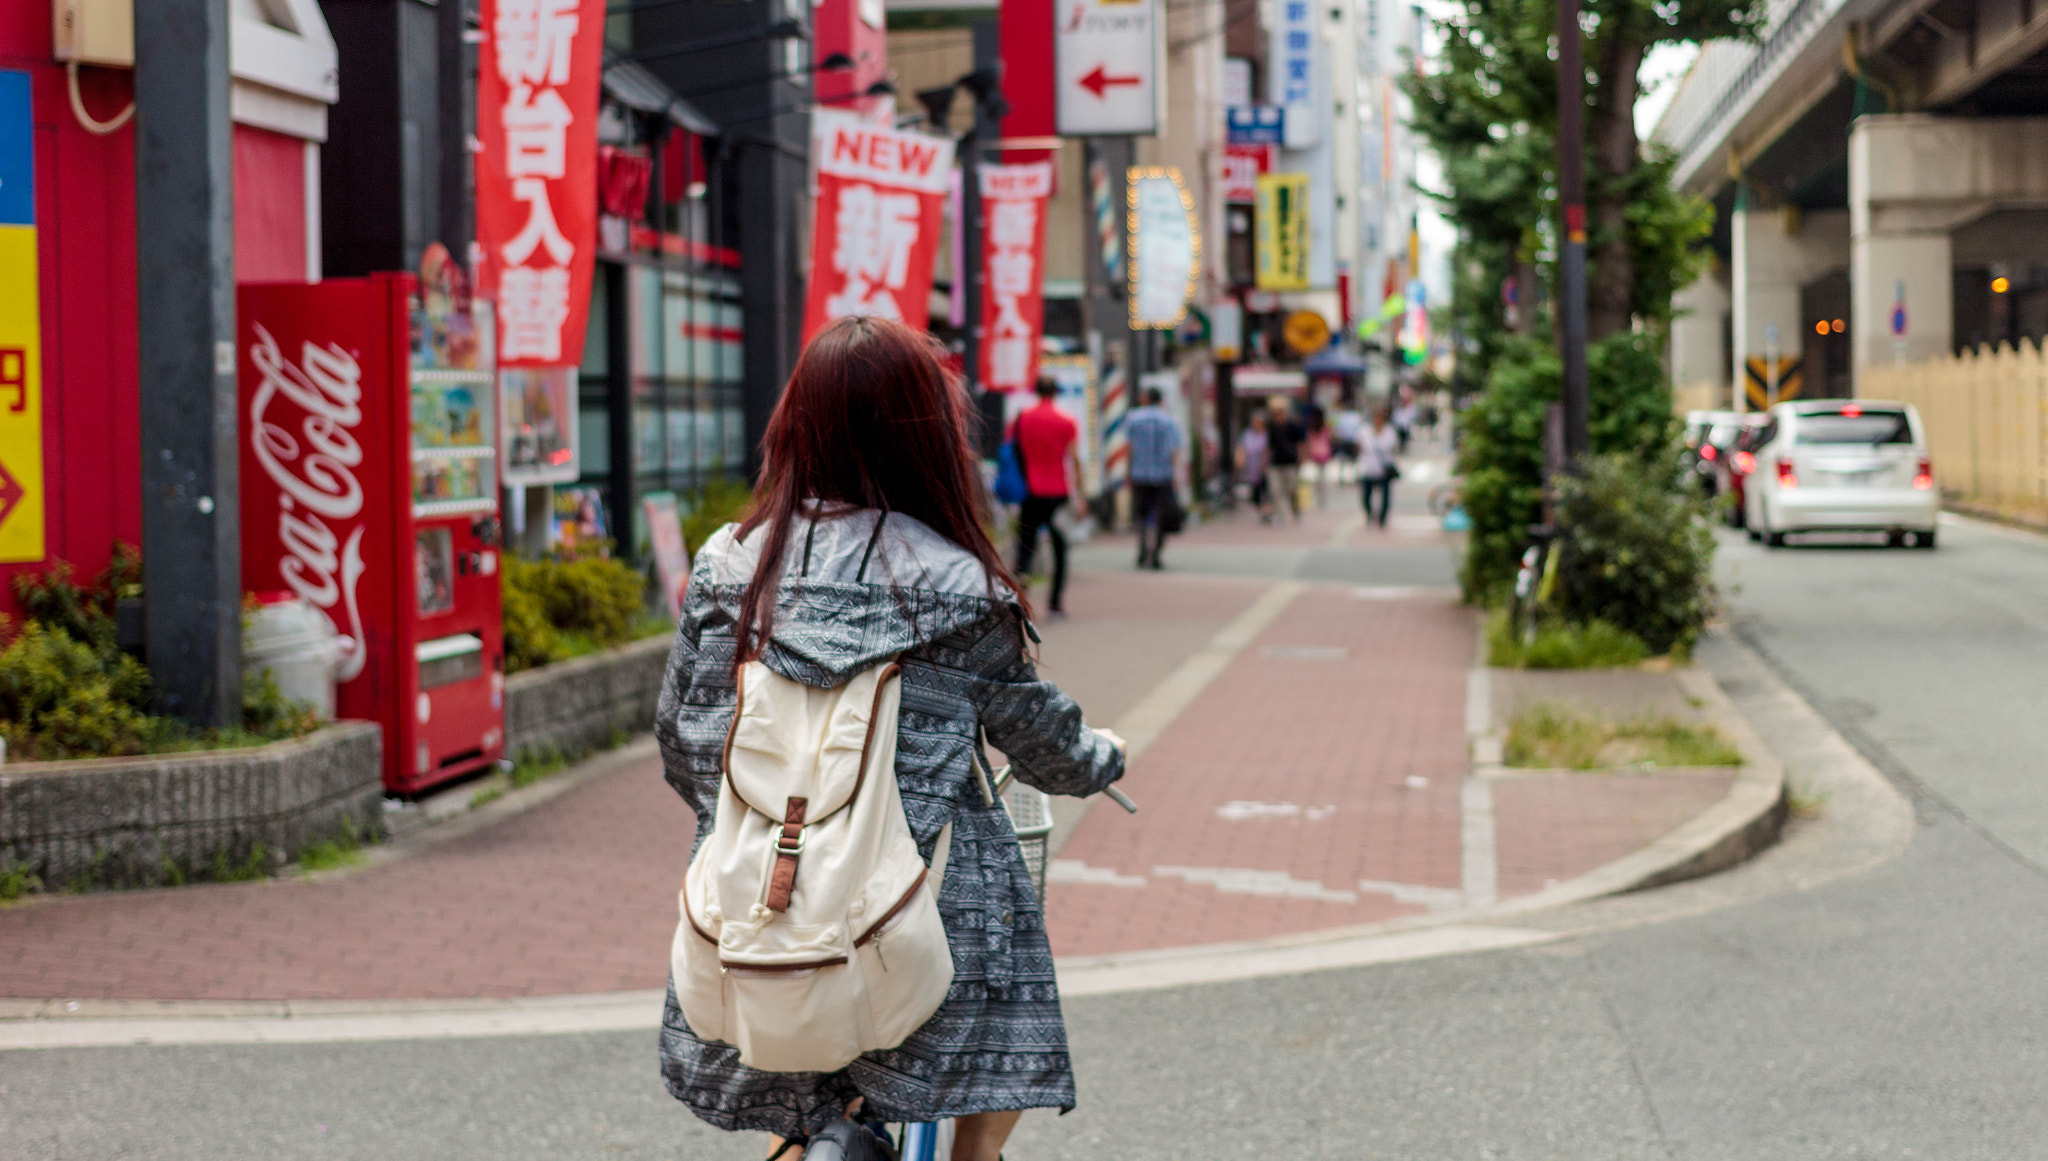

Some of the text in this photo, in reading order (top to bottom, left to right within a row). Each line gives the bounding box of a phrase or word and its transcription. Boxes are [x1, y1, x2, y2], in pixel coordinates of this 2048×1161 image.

[494, 0, 581, 361] 新台入替
[832, 128, 937, 178] NEW
